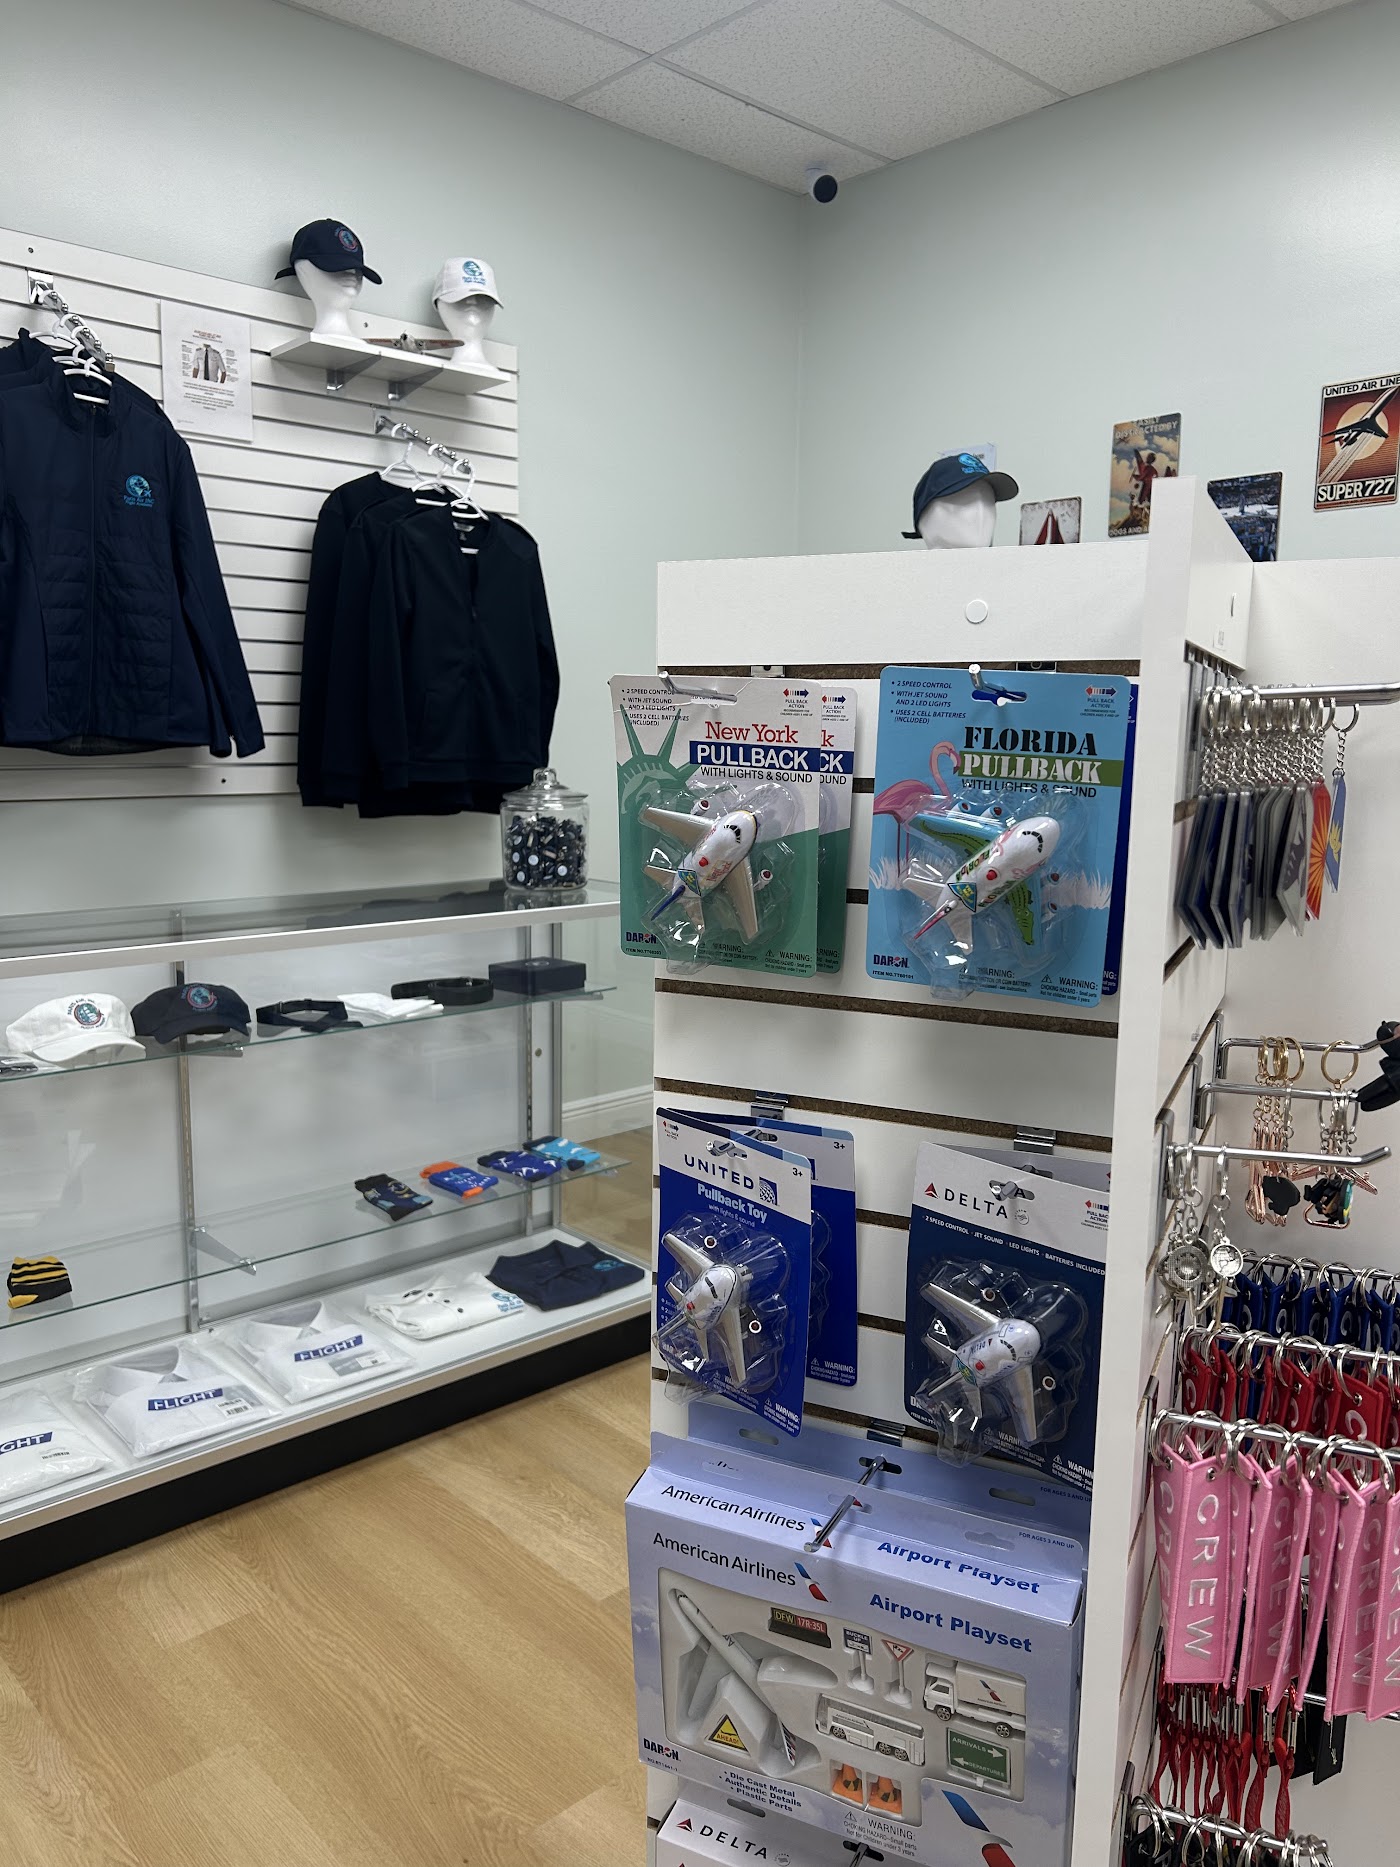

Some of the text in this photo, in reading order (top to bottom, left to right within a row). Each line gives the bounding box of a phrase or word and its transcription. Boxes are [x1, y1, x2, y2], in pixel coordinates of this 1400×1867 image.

[1325, 384, 1359, 396] UNITED
[1360, 381, 1377, 391] AIR
[1318, 478, 1395, 502] SUPER 727
[1128, 525, 1142, 535] AND
[902, 680, 922, 688] SPEED
[922, 681, 952, 689] CONTROL
[928, 700, 952, 708] LIGHTS
[894, 716, 930, 725] (INCLUDED)
[932, 711, 967, 719] BATTERIES
[705, 721, 751, 742] New
[752, 723, 799, 744] York
[964, 726, 1098, 756] FLORIDA
[697, 744, 809, 771] PULLBACK
[700, 766, 813, 784] WITH LIGHTS & SOUND
[962, 753, 1102, 785] PULLBACK
[820, 775, 847, 785] OUND
[962, 778, 993, 792] WITH
[994, 780, 1037, 795] LIGHTS
[1039, 784, 1049, 795] &
[626, 931, 657, 944] DARON
[779, 951, 813, 962] WARNING:
[817, 947, 840, 958] RNING:
[873, 954, 909, 968] DARON
[1040, 984, 1059, 993] CHOKING
[1060, 987, 1076, 995] HAZARD
[1059, 976, 1098, 991] WARNING:
[833, 1141, 846, 1150] 3+
[684, 1153, 754, 1190] UNITED
[792, 1167, 803, 1178] 3+
[697, 1182, 768, 1224] Pullback Toy
[944, 1187, 1009, 1220] DELTA
[708, 1204, 756, 1228] with lights sound
[1086, 1210, 1098, 1218] PULL
[1089, 1215, 1108, 1224] ACTION
[929, 1216, 945, 1228] SPEED
[945, 1221, 970, 1235] CONTROL
[973, 1231, 983, 1239] JET
[983, 1233, 1004, 1246] SOUND
[1009, 1241, 1020, 1250] LED
[1020, 1244, 1040, 1256] LIGHTS
[1045, 1252, 1074, 1268] BATTERIES
[1075, 1262, 1106, 1276] INCLUDED
[299, 1336, 358, 1360] FLIGHT
[824, 1360, 855, 1374] WARNING:
[153, 1389, 216, 1410] FLIGHT
[775, 1402, 800, 1424] WARNING:
[1067, 1460, 1094, 1479] WARNIN
[1040, 1486, 1051, 1494] FOR
[1052, 1489, 1067, 1498] AGES
[1071, 1493, 1084, 1501] AND
[660, 1484, 807, 1532] American Airlines
[1018, 1531, 1031, 1540] FOR
[1031, 1534, 1047, 1544] AGES
[1051, 1539, 1066, 1548] AND
[1066, 1542, 1076, 1550] UP
[653, 1531, 797, 1587] American Airlines
[877, 1541, 1040, 1594] Airport Playset
[1184, 1493, 1220, 1660] CREW
[1266, 1495, 1292, 1658] CREW
[1352, 1517, 1382, 1686] CREW
[775, 1611, 825, 1632] DFW 17R-35L
[869, 1593, 1032, 1653] Airport Playset
[845, 1630, 868, 1641] BUCKLE
[643, 1737, 680, 1762] DARON
[952, 1736, 987, 1753] ARRIVALS
[968, 1762, 1005, 1778] DEPARTURES
[724, 1777, 802, 1808] Authentic Details
[729, 1771, 796, 1799] Die Cast Metal
[736, 1787, 794, 1812] Plastic Parts
[867, 1818, 916, 1842] WARNING:
[699, 1824, 769, 1860] DELTA
